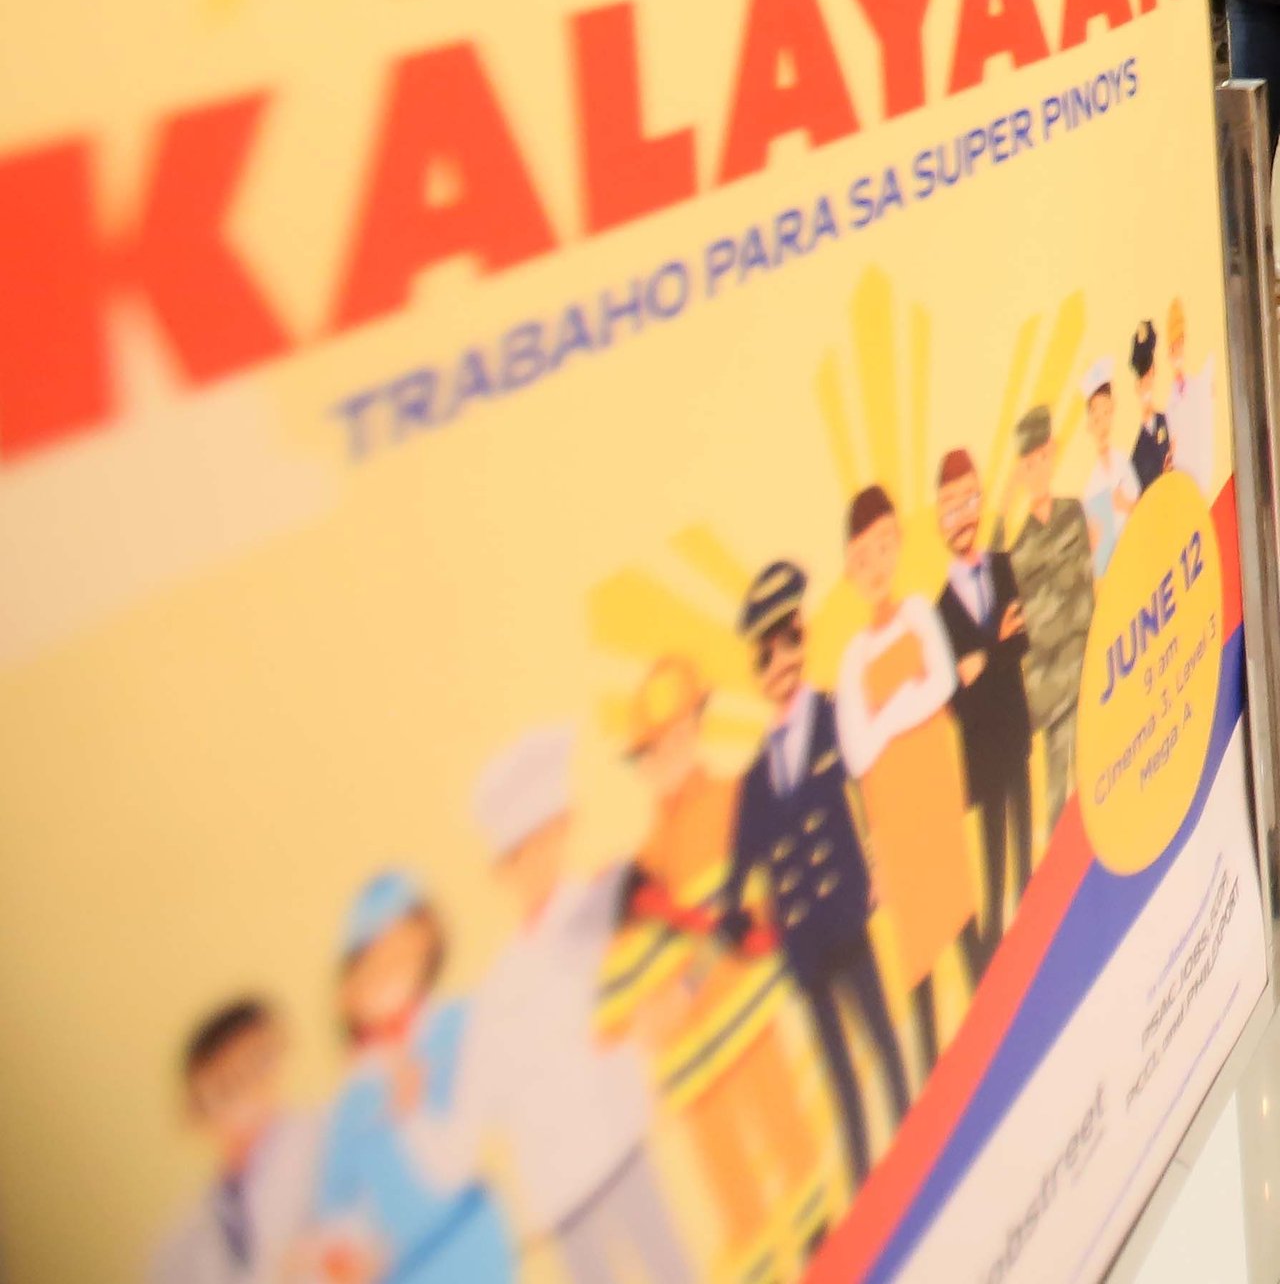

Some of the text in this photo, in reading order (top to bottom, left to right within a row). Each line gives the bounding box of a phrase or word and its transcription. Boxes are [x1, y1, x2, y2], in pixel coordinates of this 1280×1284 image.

[332, 55, 1141, 462] TRABAHO PARA SA SUPER PINOYS
[1100, 529, 1204, 706] JUNE 12
[1094, 714, 1157, 806] Cinema
[1176, 626, 1207, 695] Level
[1138, 724, 1179, 793] Mega
[984, 1080, 1106, 1284] obstreet
